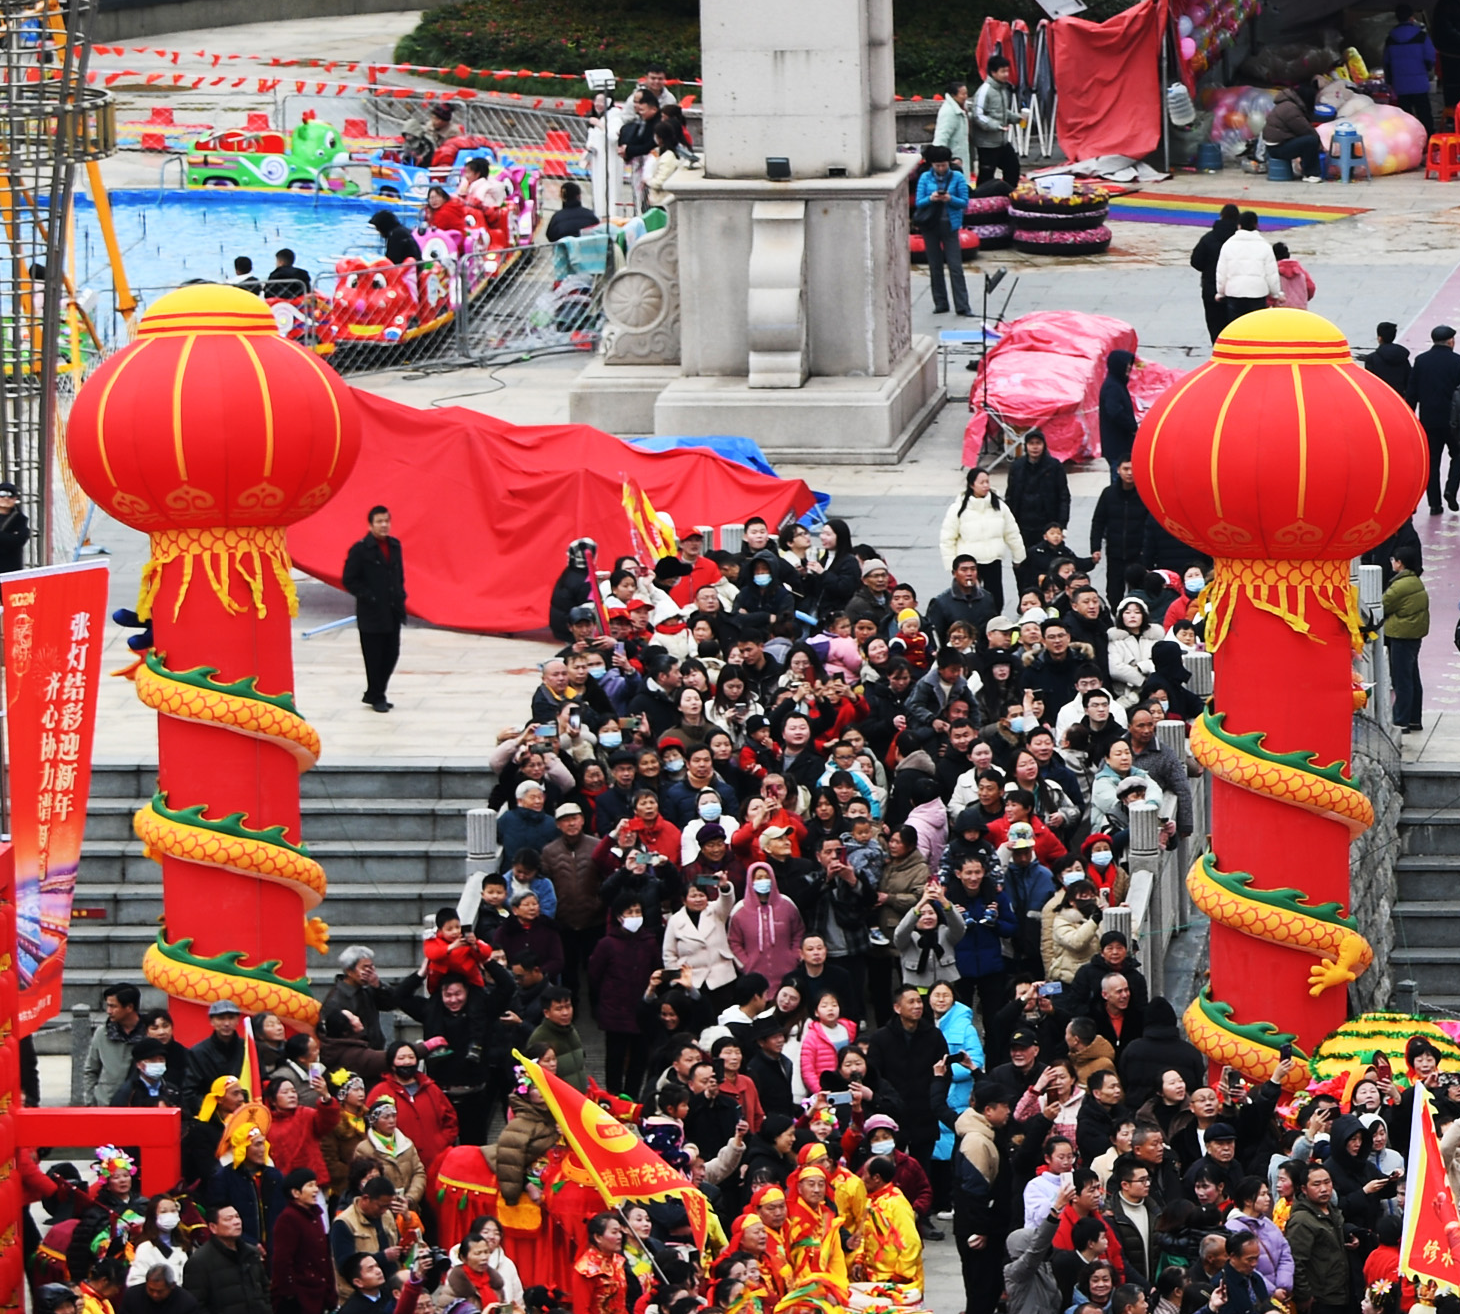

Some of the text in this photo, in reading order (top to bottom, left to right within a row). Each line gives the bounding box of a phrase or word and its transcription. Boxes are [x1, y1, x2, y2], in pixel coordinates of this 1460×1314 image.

[10, 589, 36, 607] 2024
[53, 611, 92, 823] 张灯结彩迎新年
